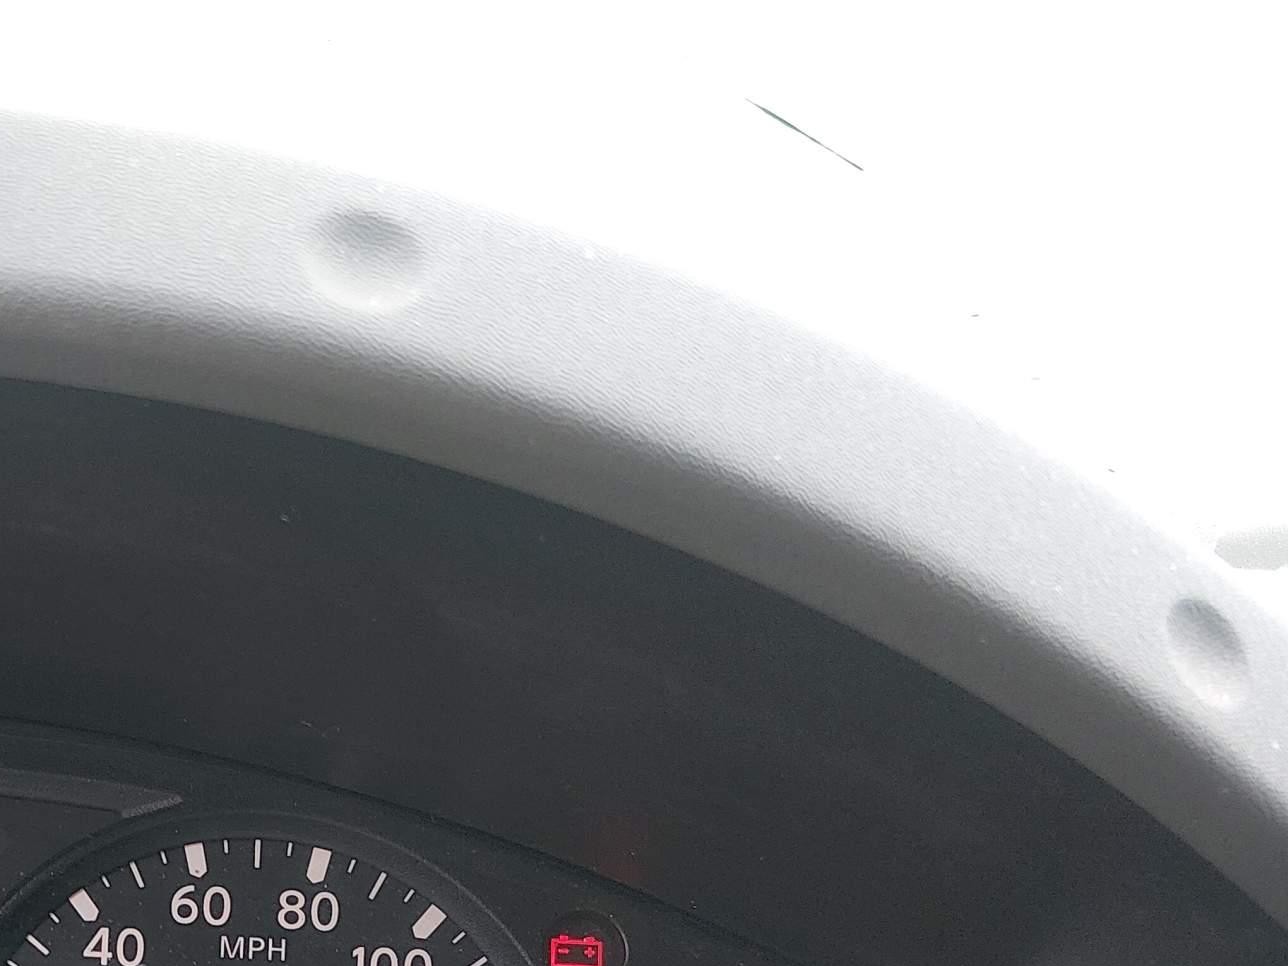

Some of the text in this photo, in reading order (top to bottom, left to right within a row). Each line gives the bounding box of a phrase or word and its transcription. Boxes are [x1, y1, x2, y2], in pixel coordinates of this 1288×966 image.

[170, 885, 232, 925] 60
[277, 889, 340, 932] 80
[219, 935, 287, 962] MPH
